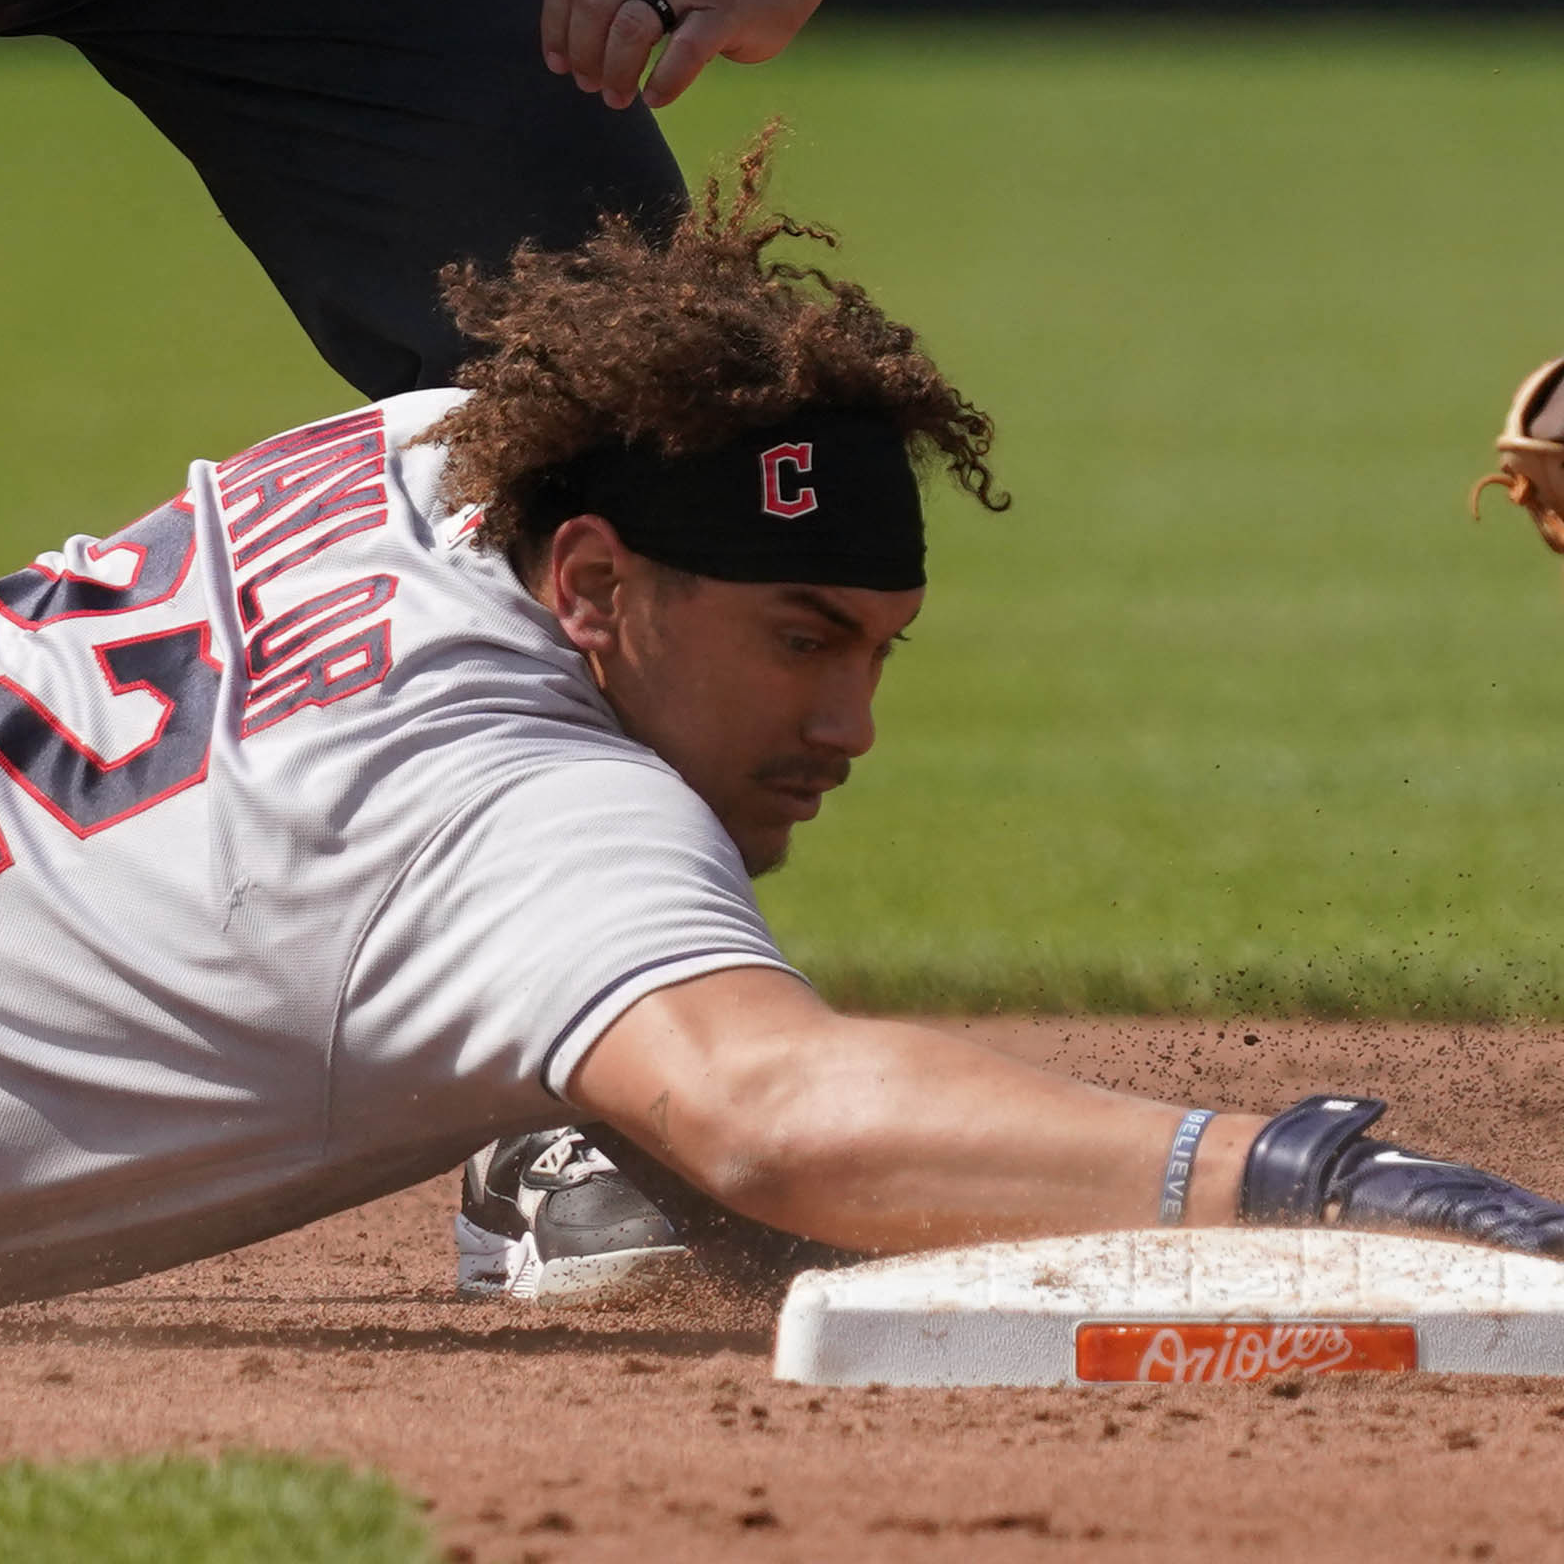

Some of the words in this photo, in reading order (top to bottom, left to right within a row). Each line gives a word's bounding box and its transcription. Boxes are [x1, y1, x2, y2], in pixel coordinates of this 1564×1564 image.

[760, 442, 819, 519] C
[215, 408, 400, 742] NAYLOR
[1164, 1114, 1207, 1214] BELIEVE
[1137, 1323, 1354, 1386] Orioles
